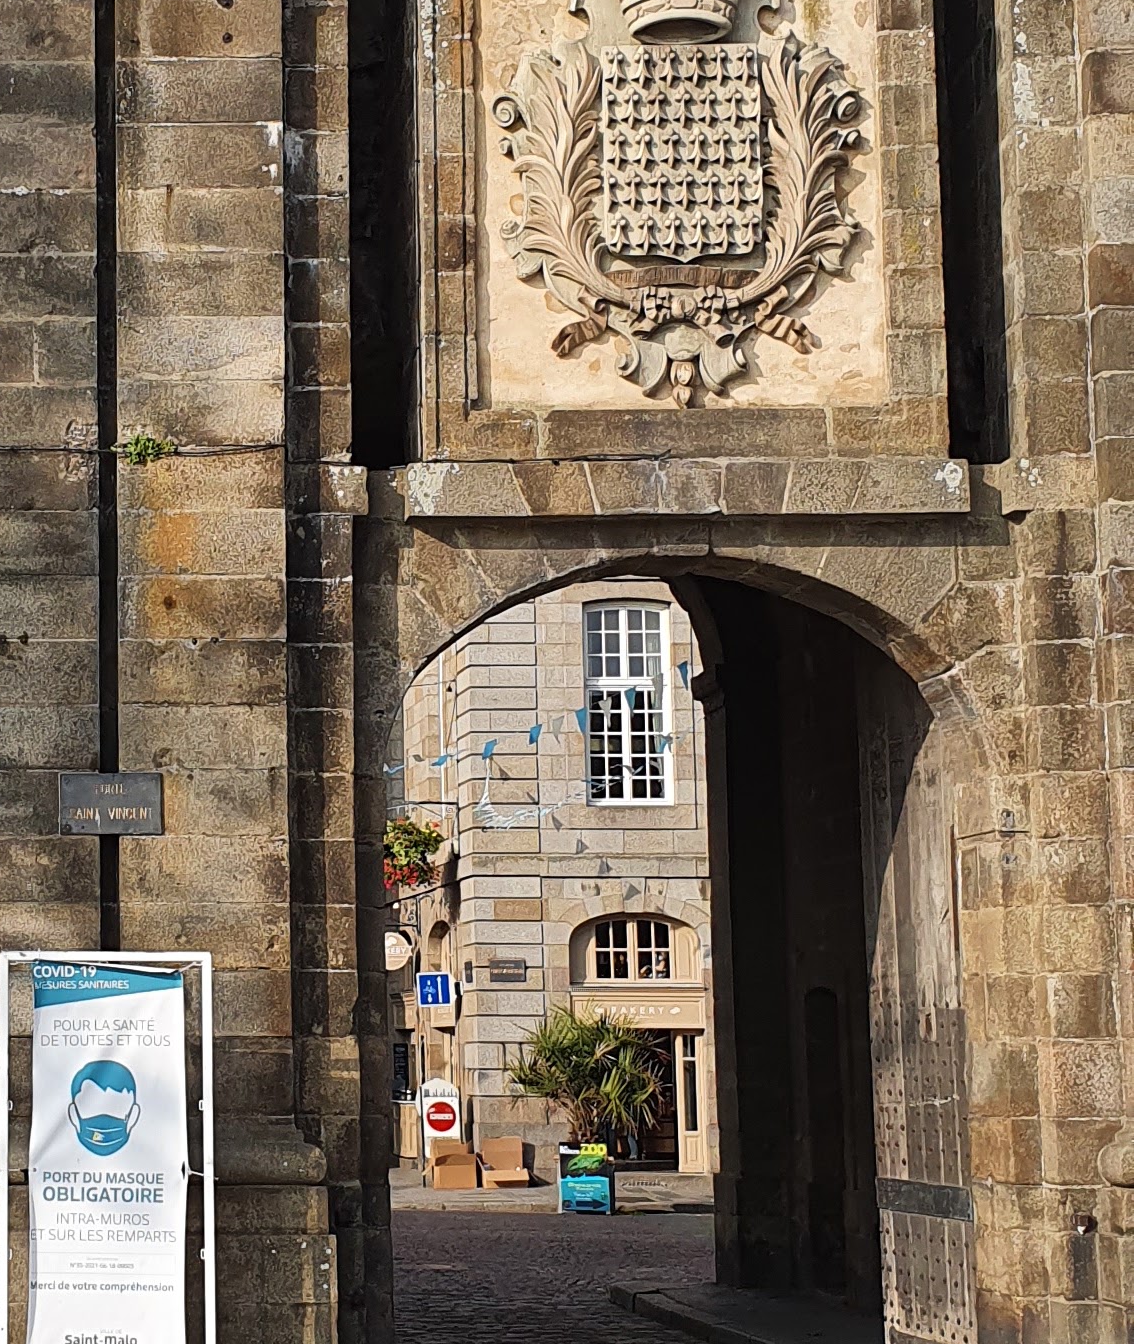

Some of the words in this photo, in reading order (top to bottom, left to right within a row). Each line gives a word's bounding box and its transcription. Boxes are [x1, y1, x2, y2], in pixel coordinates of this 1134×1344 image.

[33, 965, 97, 978] COVID-19
[78, 979, 129, 989] SANITAIRES
[610, 1006, 665, 1015] BAKERY
[53, 1019, 91, 1031] POUR
[94, 1019, 110, 1031] LA
[113, 1017, 155, 1031] SANTÉ
[40, 1034, 59, 1047] DE
[62, 1034, 113, 1046] TOUTES
[116, 1034, 132, 1046] ET
[135, 1034, 171, 1047] TOUS
[579, 1143, 608, 1155] ZOO
[42, 1171, 80, 1184] PORT
[82, 1172, 102, 1184] DU
[105, 1172, 164, 1186] MASQUE
[42, 1186, 164, 1203] OBLIGATOIRE
[56, 1212, 150, 1226] INTRA-MUROS
[30, 1228, 45, 1241] ET
[48, 1228, 76, 1241] SUR
[79, 1229, 104, 1242] LES
[107, 1230, 177, 1243] REMPARTS
[30, 1280, 56, 1291] Merci
[57, 1281, 70, 1291] de
[72, 1282, 98, 1291] votre
[99, 1282, 174, 1293] compréhension
